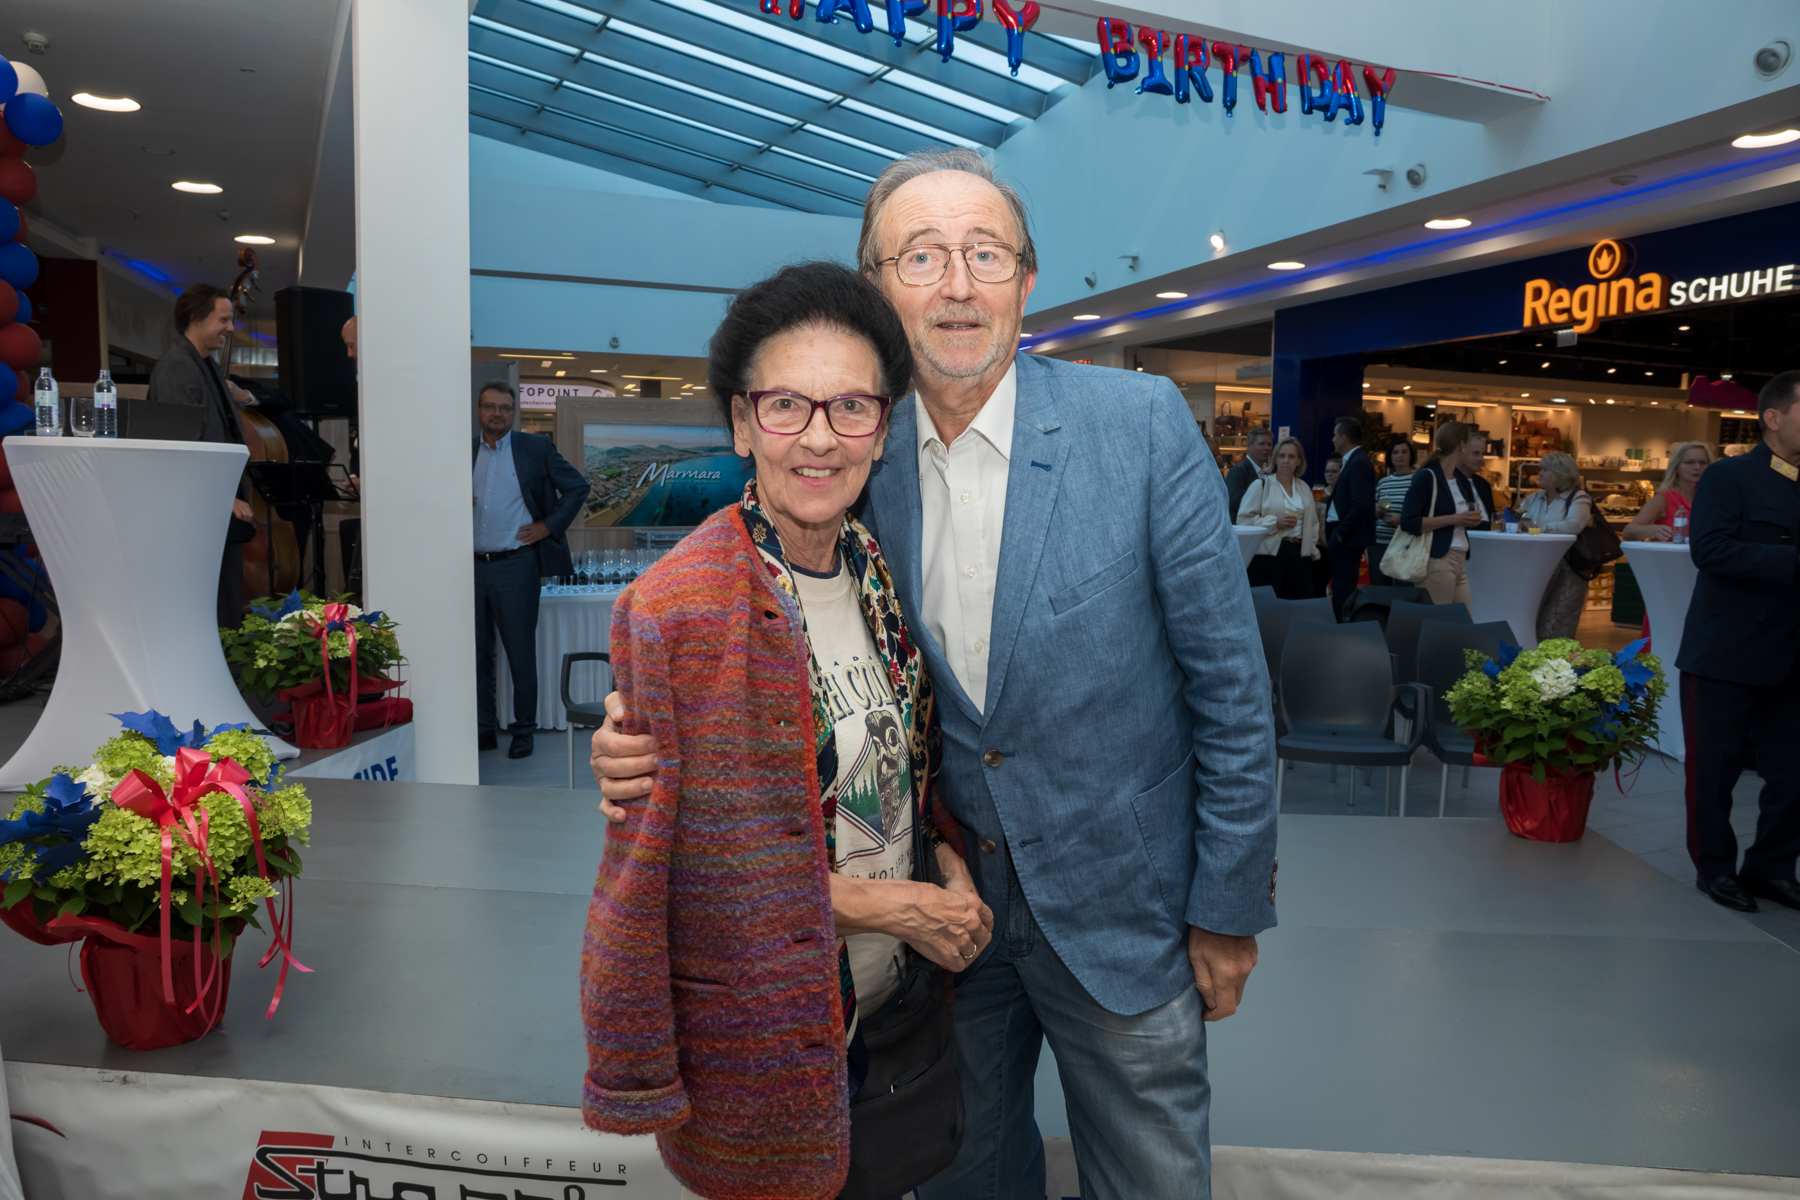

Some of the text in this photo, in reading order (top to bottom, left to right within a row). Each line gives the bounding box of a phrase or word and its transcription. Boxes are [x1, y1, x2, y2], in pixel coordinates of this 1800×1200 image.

[759, 0, 1396, 137] PPY BIRTHDAY
[1523, 264, 1796, 334] Regina SCHUHE
[635, 462, 722, 489] Marmara
[344, 1136, 627, 1175] INTERCOIFFEUR
